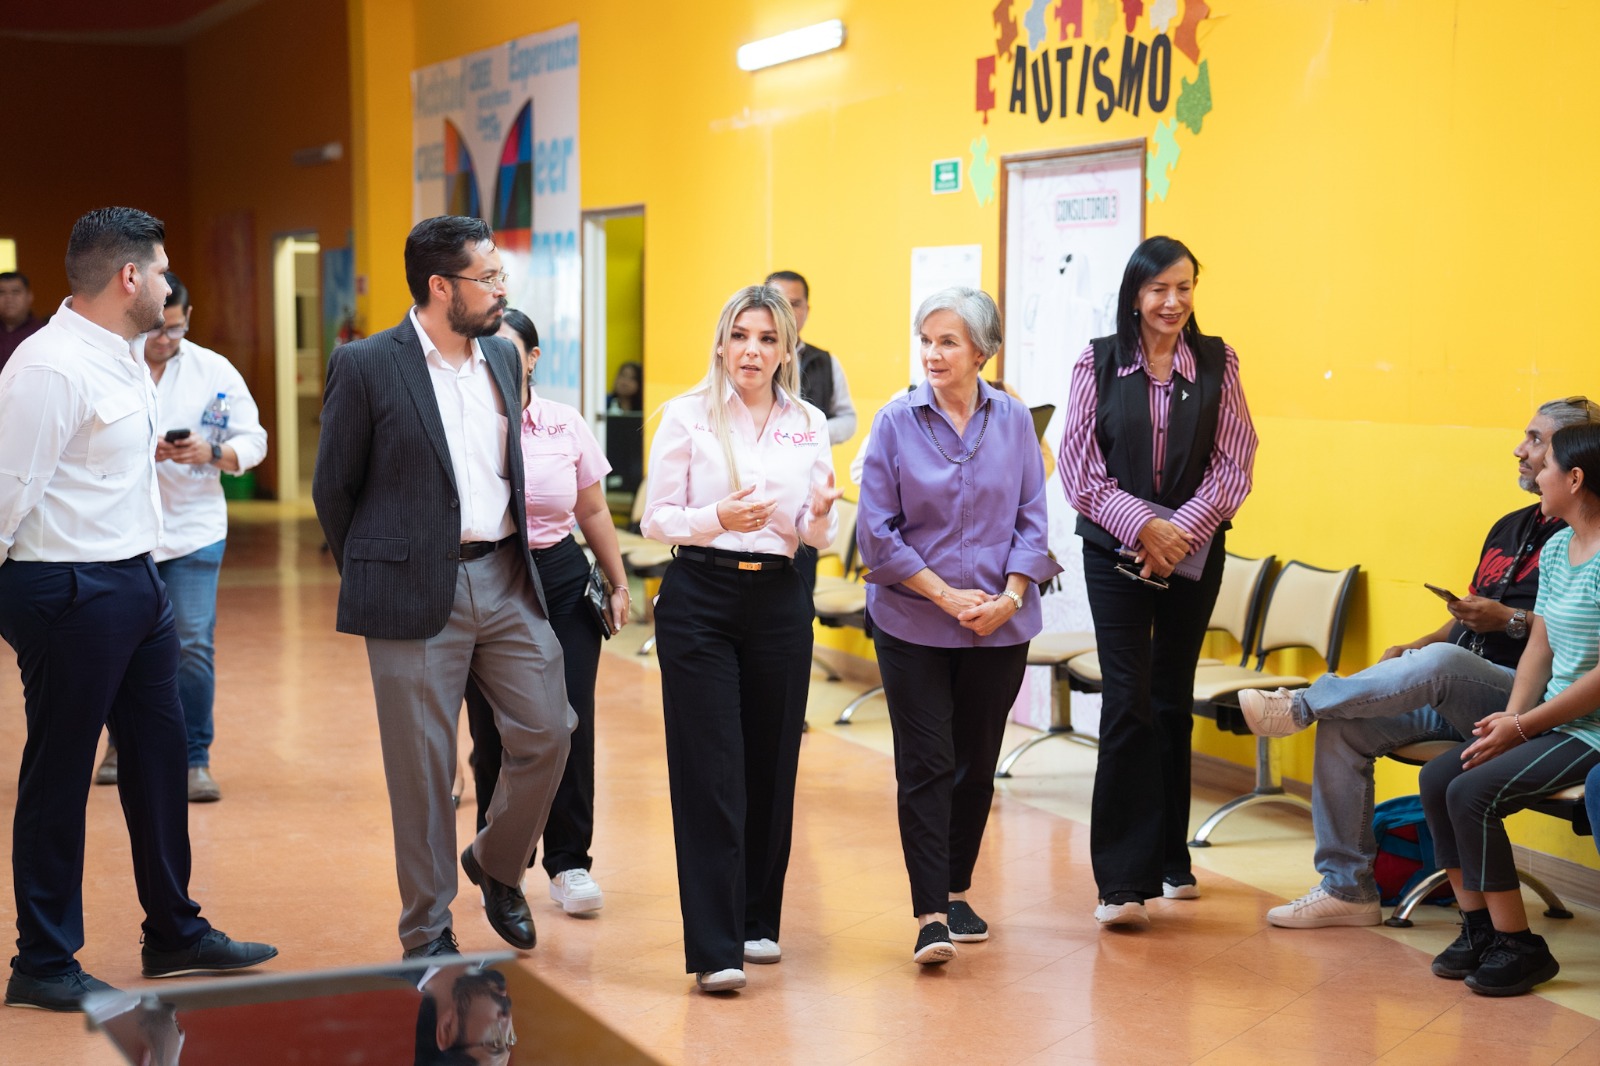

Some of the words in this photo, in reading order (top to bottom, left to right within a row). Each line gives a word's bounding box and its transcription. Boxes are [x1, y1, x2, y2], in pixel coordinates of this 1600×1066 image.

[1009, 33, 1172, 124] AUTISMO
[1056, 196, 1109, 222] CONSULTORIO
[1111, 195, 1117, 219] 3
[547, 424, 567, 436] DIF
[792, 431, 817, 444] DIF
